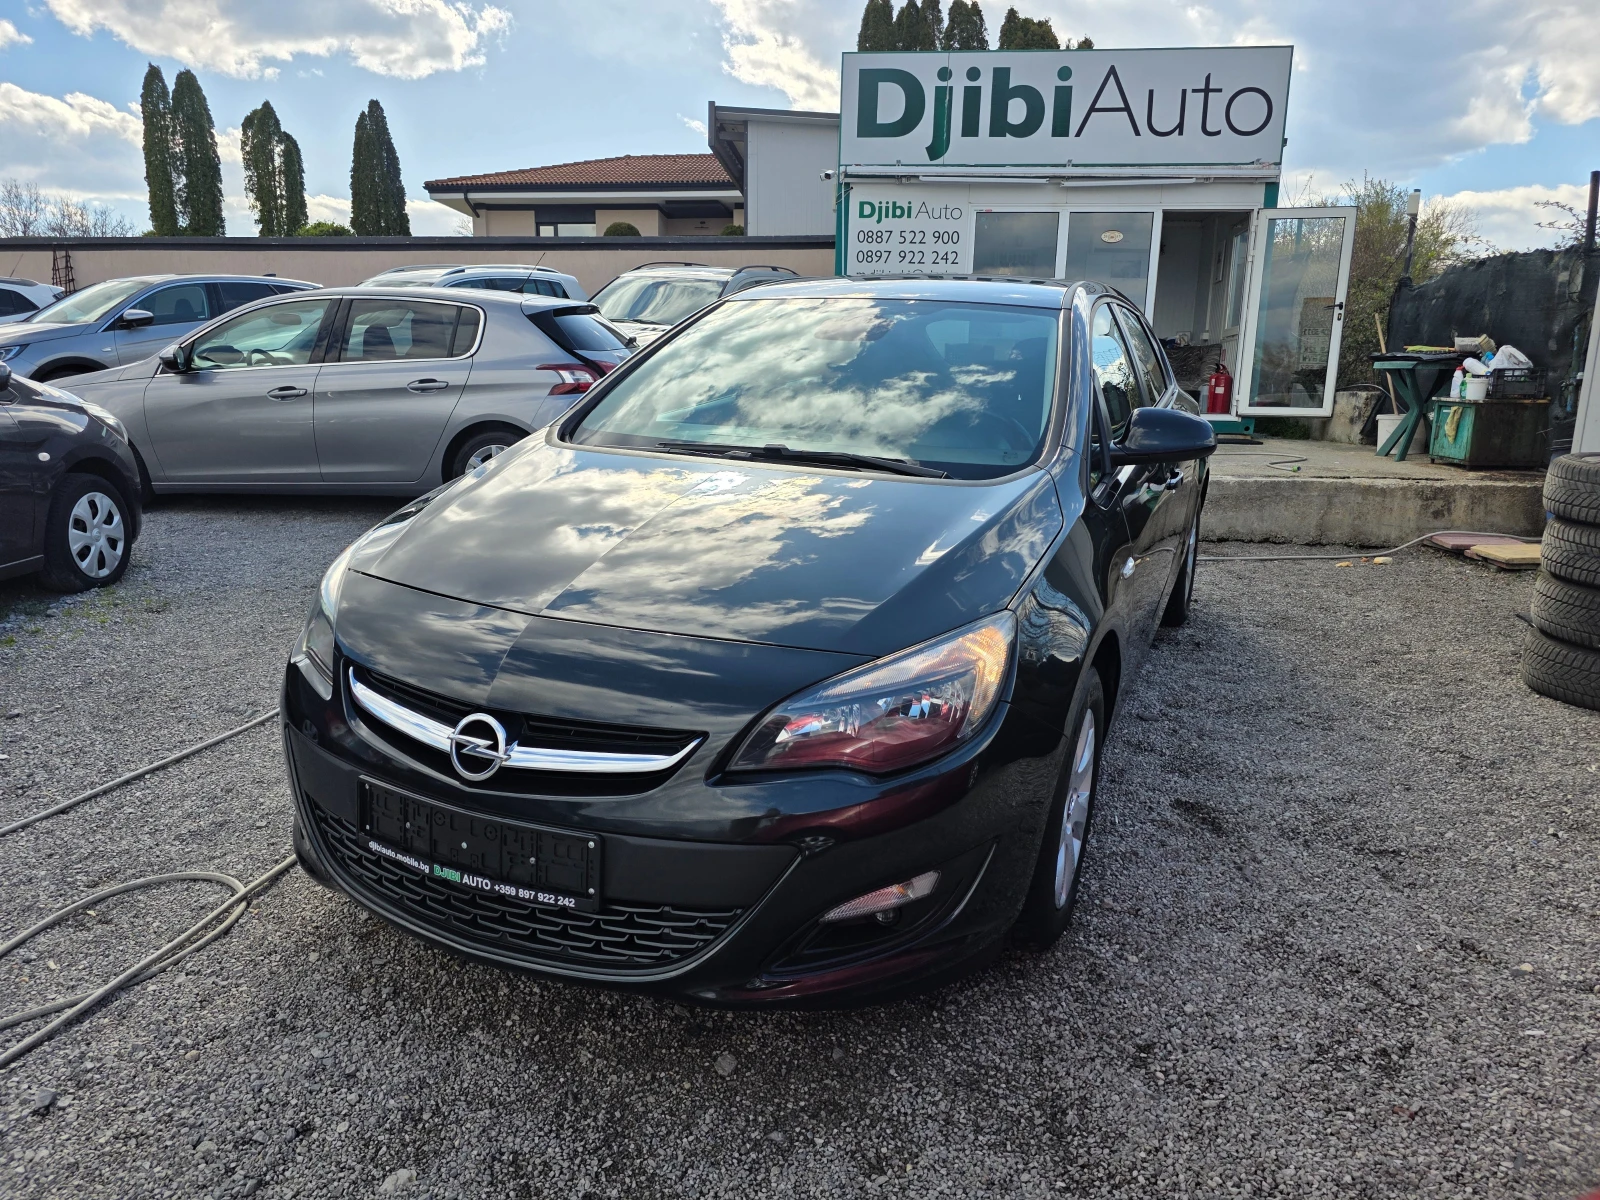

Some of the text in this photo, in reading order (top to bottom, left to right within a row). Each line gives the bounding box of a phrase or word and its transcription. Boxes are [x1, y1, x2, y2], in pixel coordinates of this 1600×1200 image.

[857, 230, 960, 245] 0887 522 900
[856, 250, 959, 265] 0897 922 242
[368, 840, 576, 908] djibiauto.mobile.bg DJIBI AUTO +359 897 922 242
